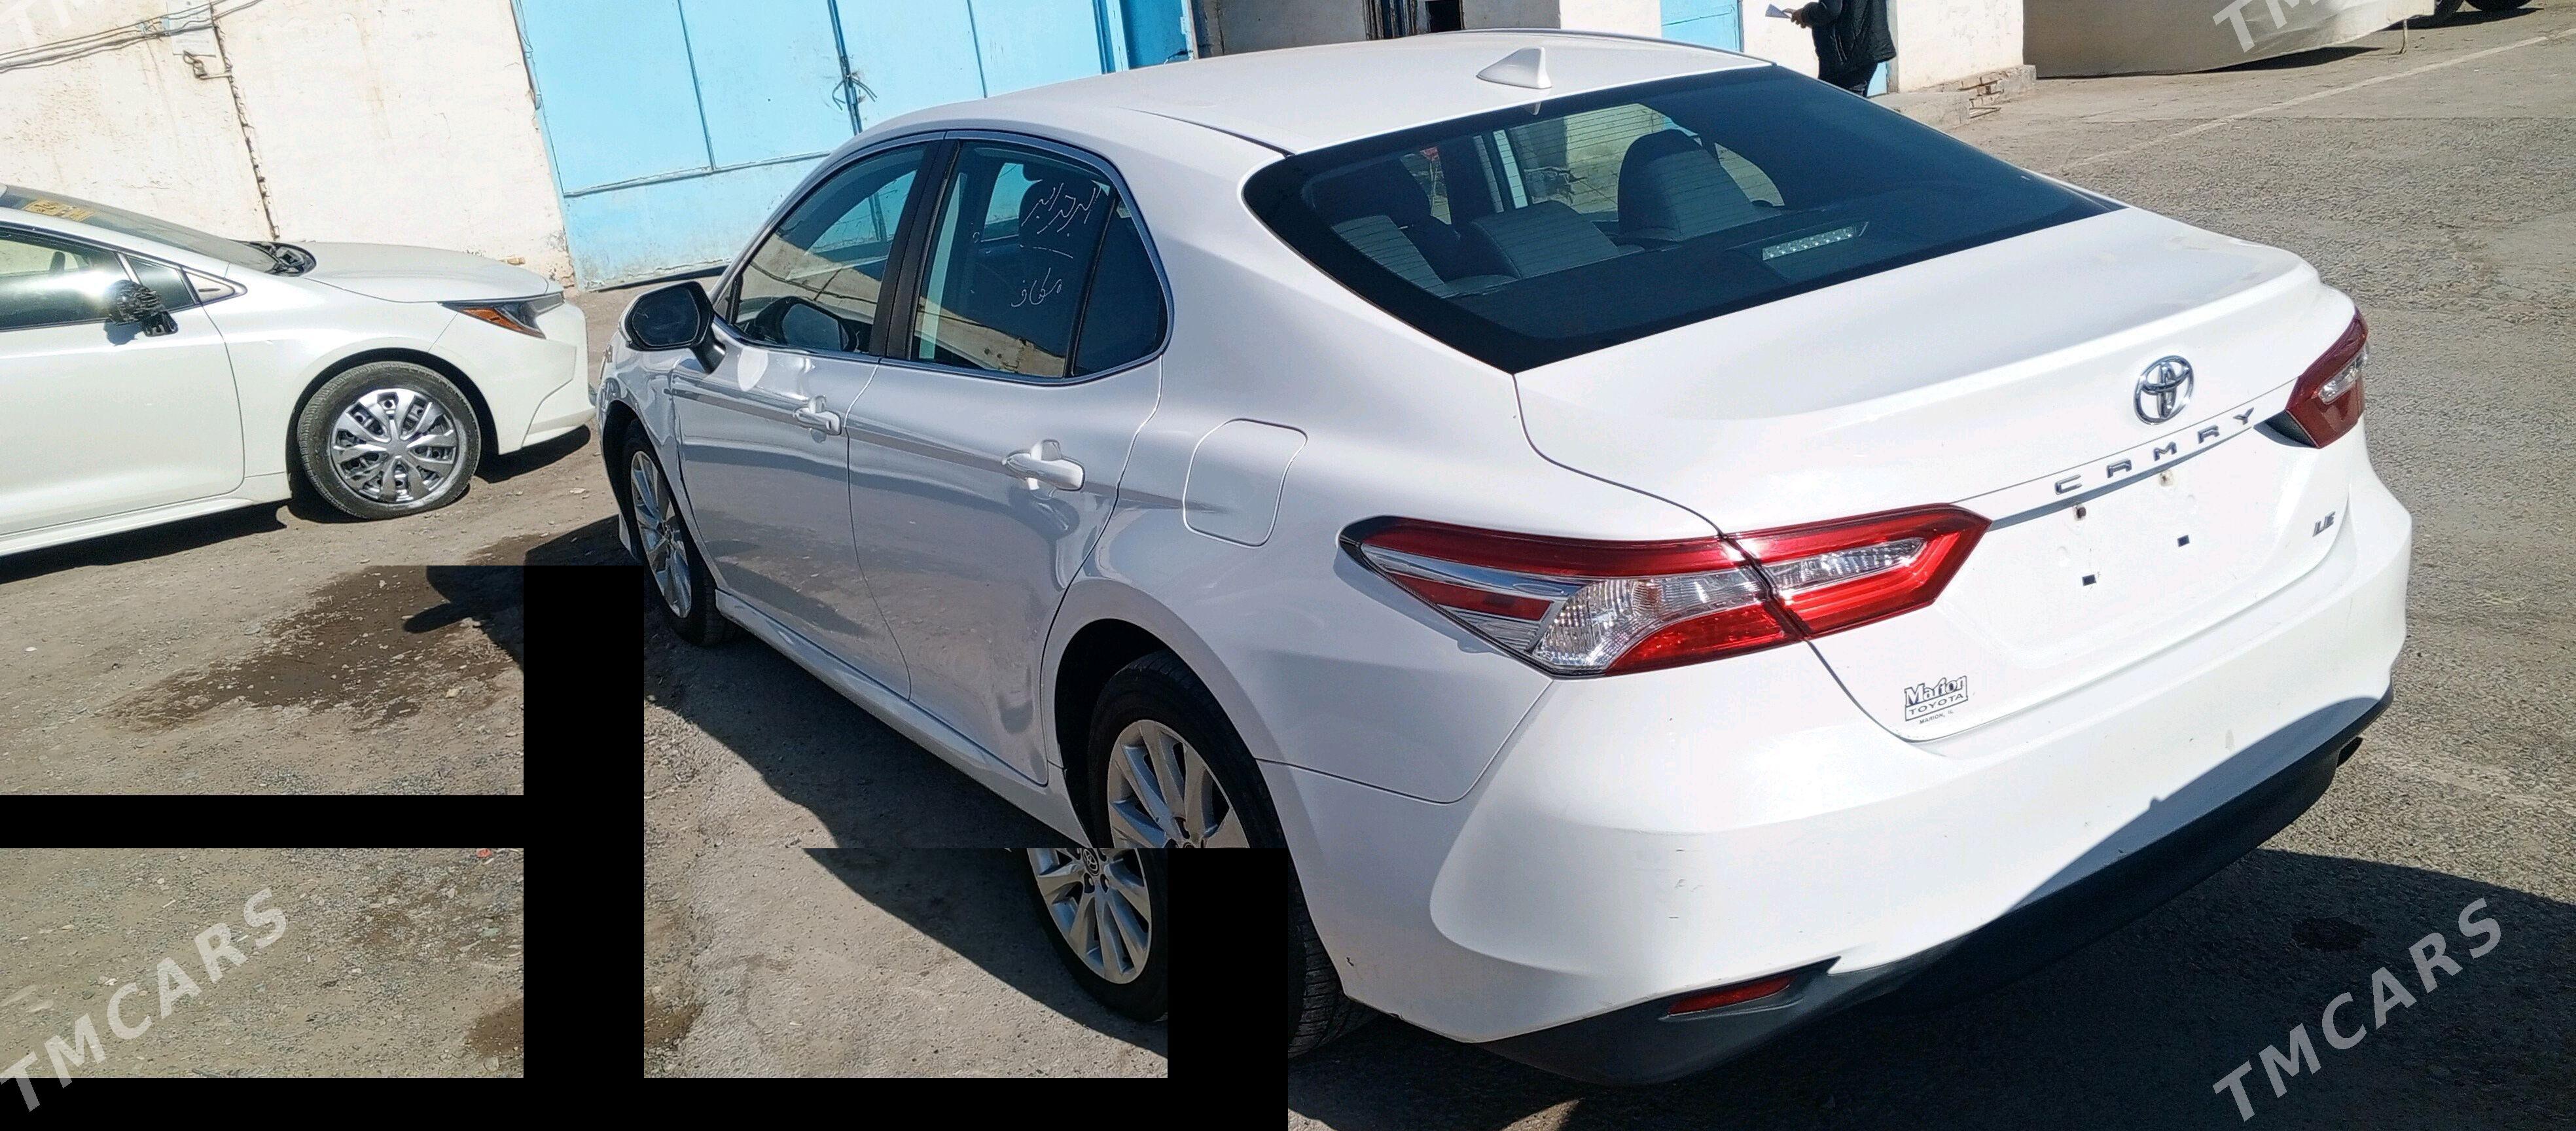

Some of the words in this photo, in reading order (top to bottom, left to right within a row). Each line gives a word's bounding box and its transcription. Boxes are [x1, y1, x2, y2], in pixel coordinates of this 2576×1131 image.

[2054, 406, 2254, 495] CAMRY
[2312, 511, 2336, 537] LE
[1908, 693, 1963, 715] TOYOTA
[1919, 713, 1945, 724] MARION,
